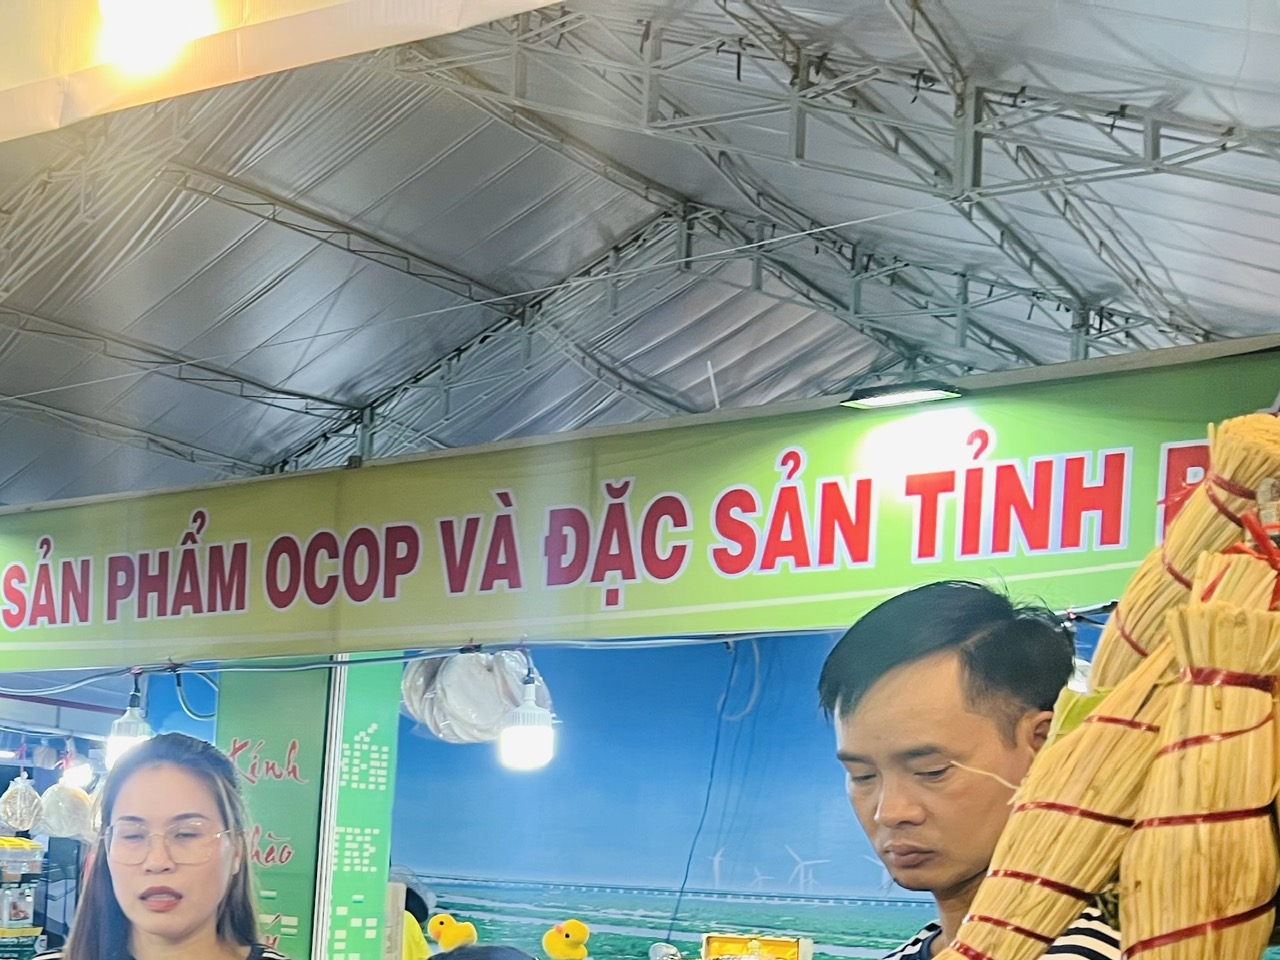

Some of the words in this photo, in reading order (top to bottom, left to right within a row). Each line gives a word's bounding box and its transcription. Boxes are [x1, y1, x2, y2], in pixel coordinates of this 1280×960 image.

[1, 536, 90, 629] SẢN
[107, 509, 249, 621] PHẨM
[265, 523, 419, 611] OCOP
[439, 490, 522, 595] VÀ
[544, 477, 693, 609] ĐẶC
[711, 447, 876, 577] SẢN
[905, 428, 1131, 563] TỈNH
[228, 738, 309, 785] Kính
[246, 824, 296, 867] hào
